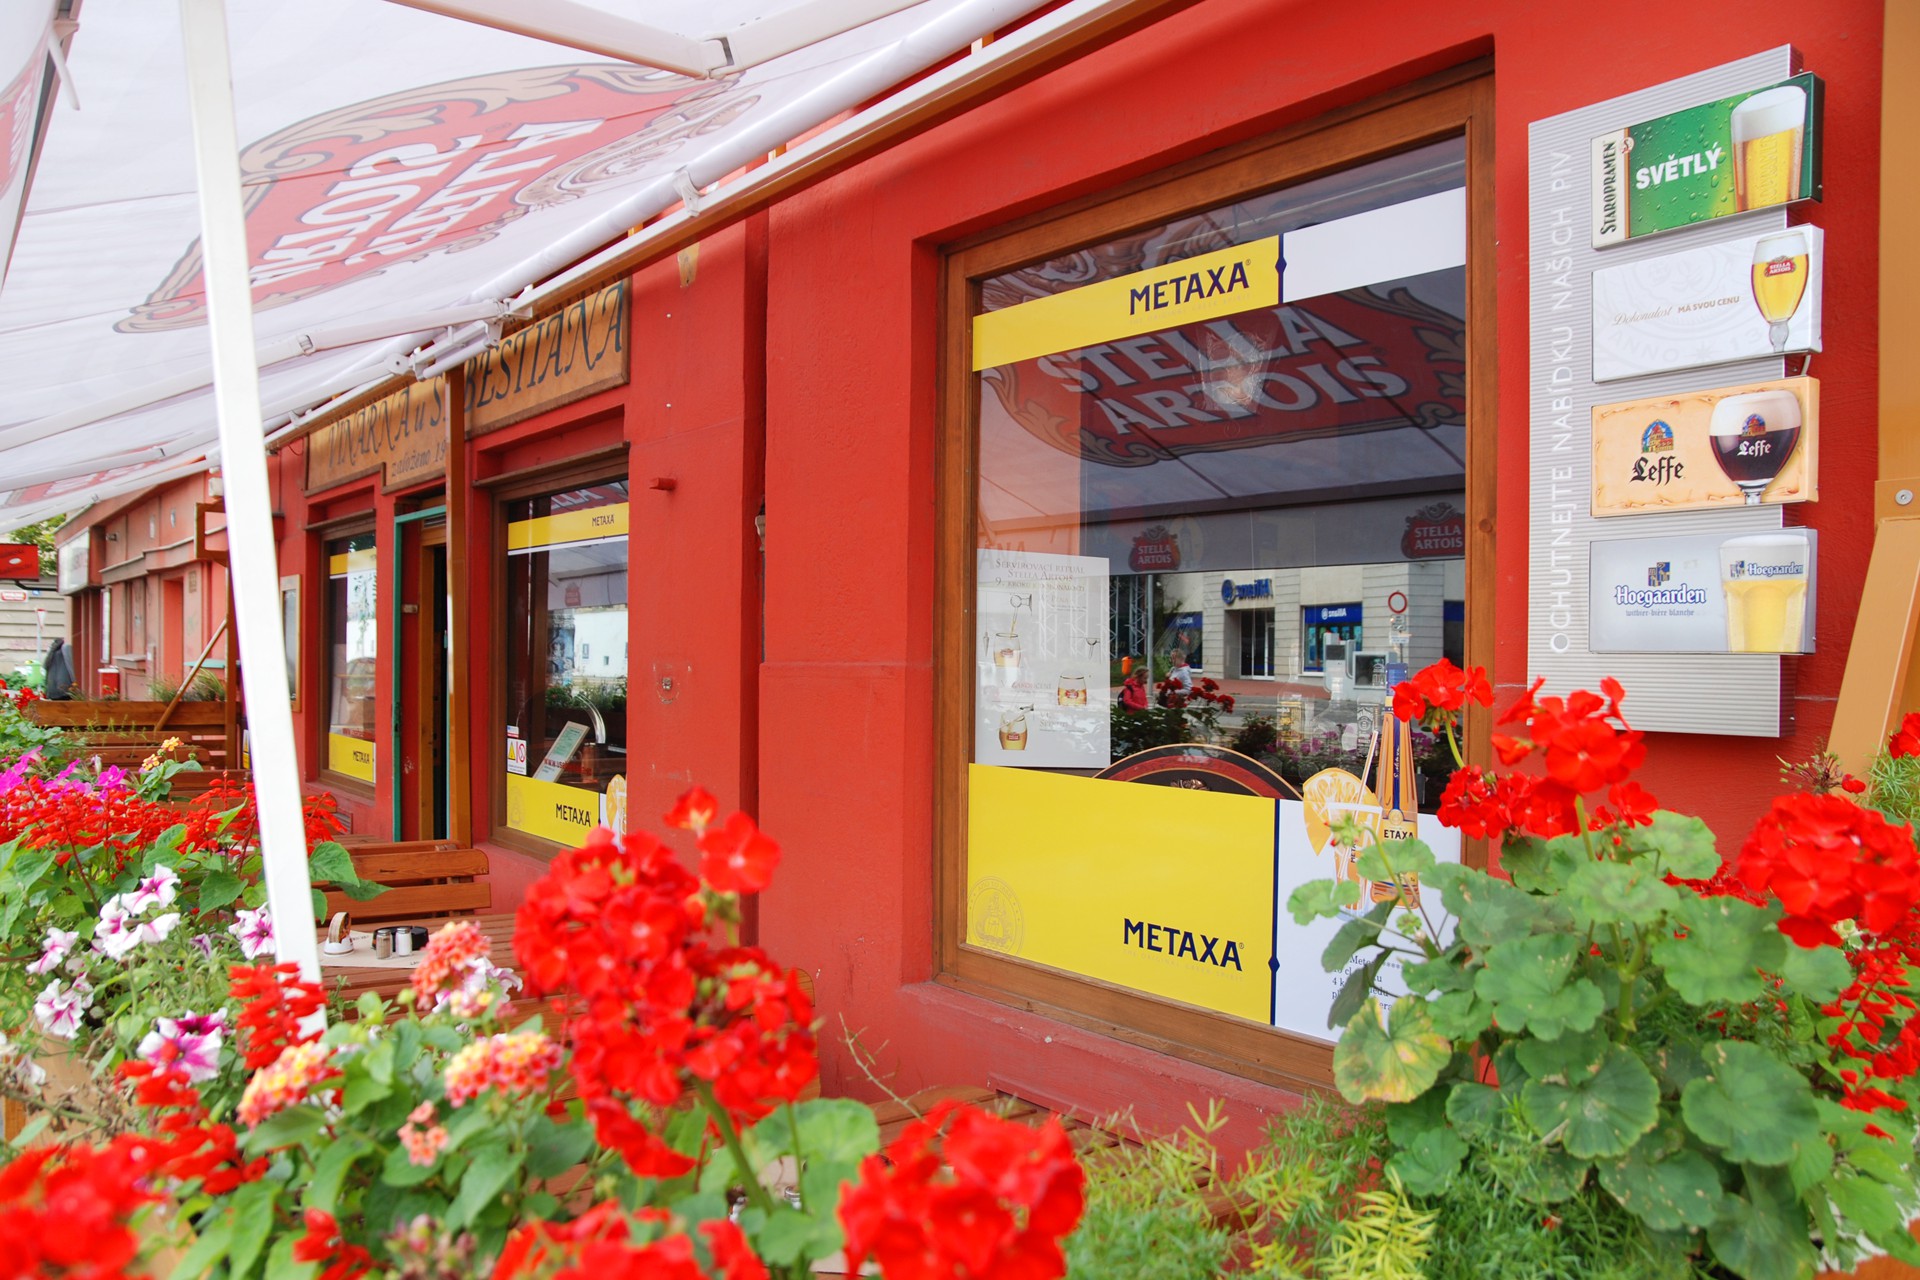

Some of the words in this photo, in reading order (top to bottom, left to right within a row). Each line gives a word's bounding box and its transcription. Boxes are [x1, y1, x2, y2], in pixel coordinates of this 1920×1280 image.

[1551, 151, 1572, 192] PIV
[1635, 141, 1722, 190] SVĚTLÝ
[1600, 141, 1616, 235] STAROPRAMEN
[1546, 206, 1573, 311] NAŠICH
[1769, 261, 1791, 271] STELLA
[1129, 261, 1250, 316] METAXA
[1612, 306, 1673, 326] Dokonalost
[1693, 300, 1716, 311] SVOU
[1717, 296, 1740, 307] CENU
[1037, 306, 1364, 394] STELLA
[1094, 354, 1408, 436] ARTOIS
[1547, 326, 1573, 451] NABÍDKU
[1737, 439, 1772, 457] Leffe
[1629, 455, 1684, 487] Leffe
[592, 514, 615, 527] METAXA
[1414, 525, 1462, 538] STELLA
[1138, 544, 1172, 555] STELLA
[1414, 537, 1463, 550] ARTOIS
[1137, 554, 1172, 565] ARTOIS
[1550, 466, 1577, 654] OCHUTNEJTE
[1747, 561, 1803, 578] Hoegaarden
[1614, 583, 1707, 607] Hoegaarden
[1668, 608, 1695, 618] blanche
[555, 803, 592, 828] METAXA
[1123, 918, 1243, 972] METAXA
